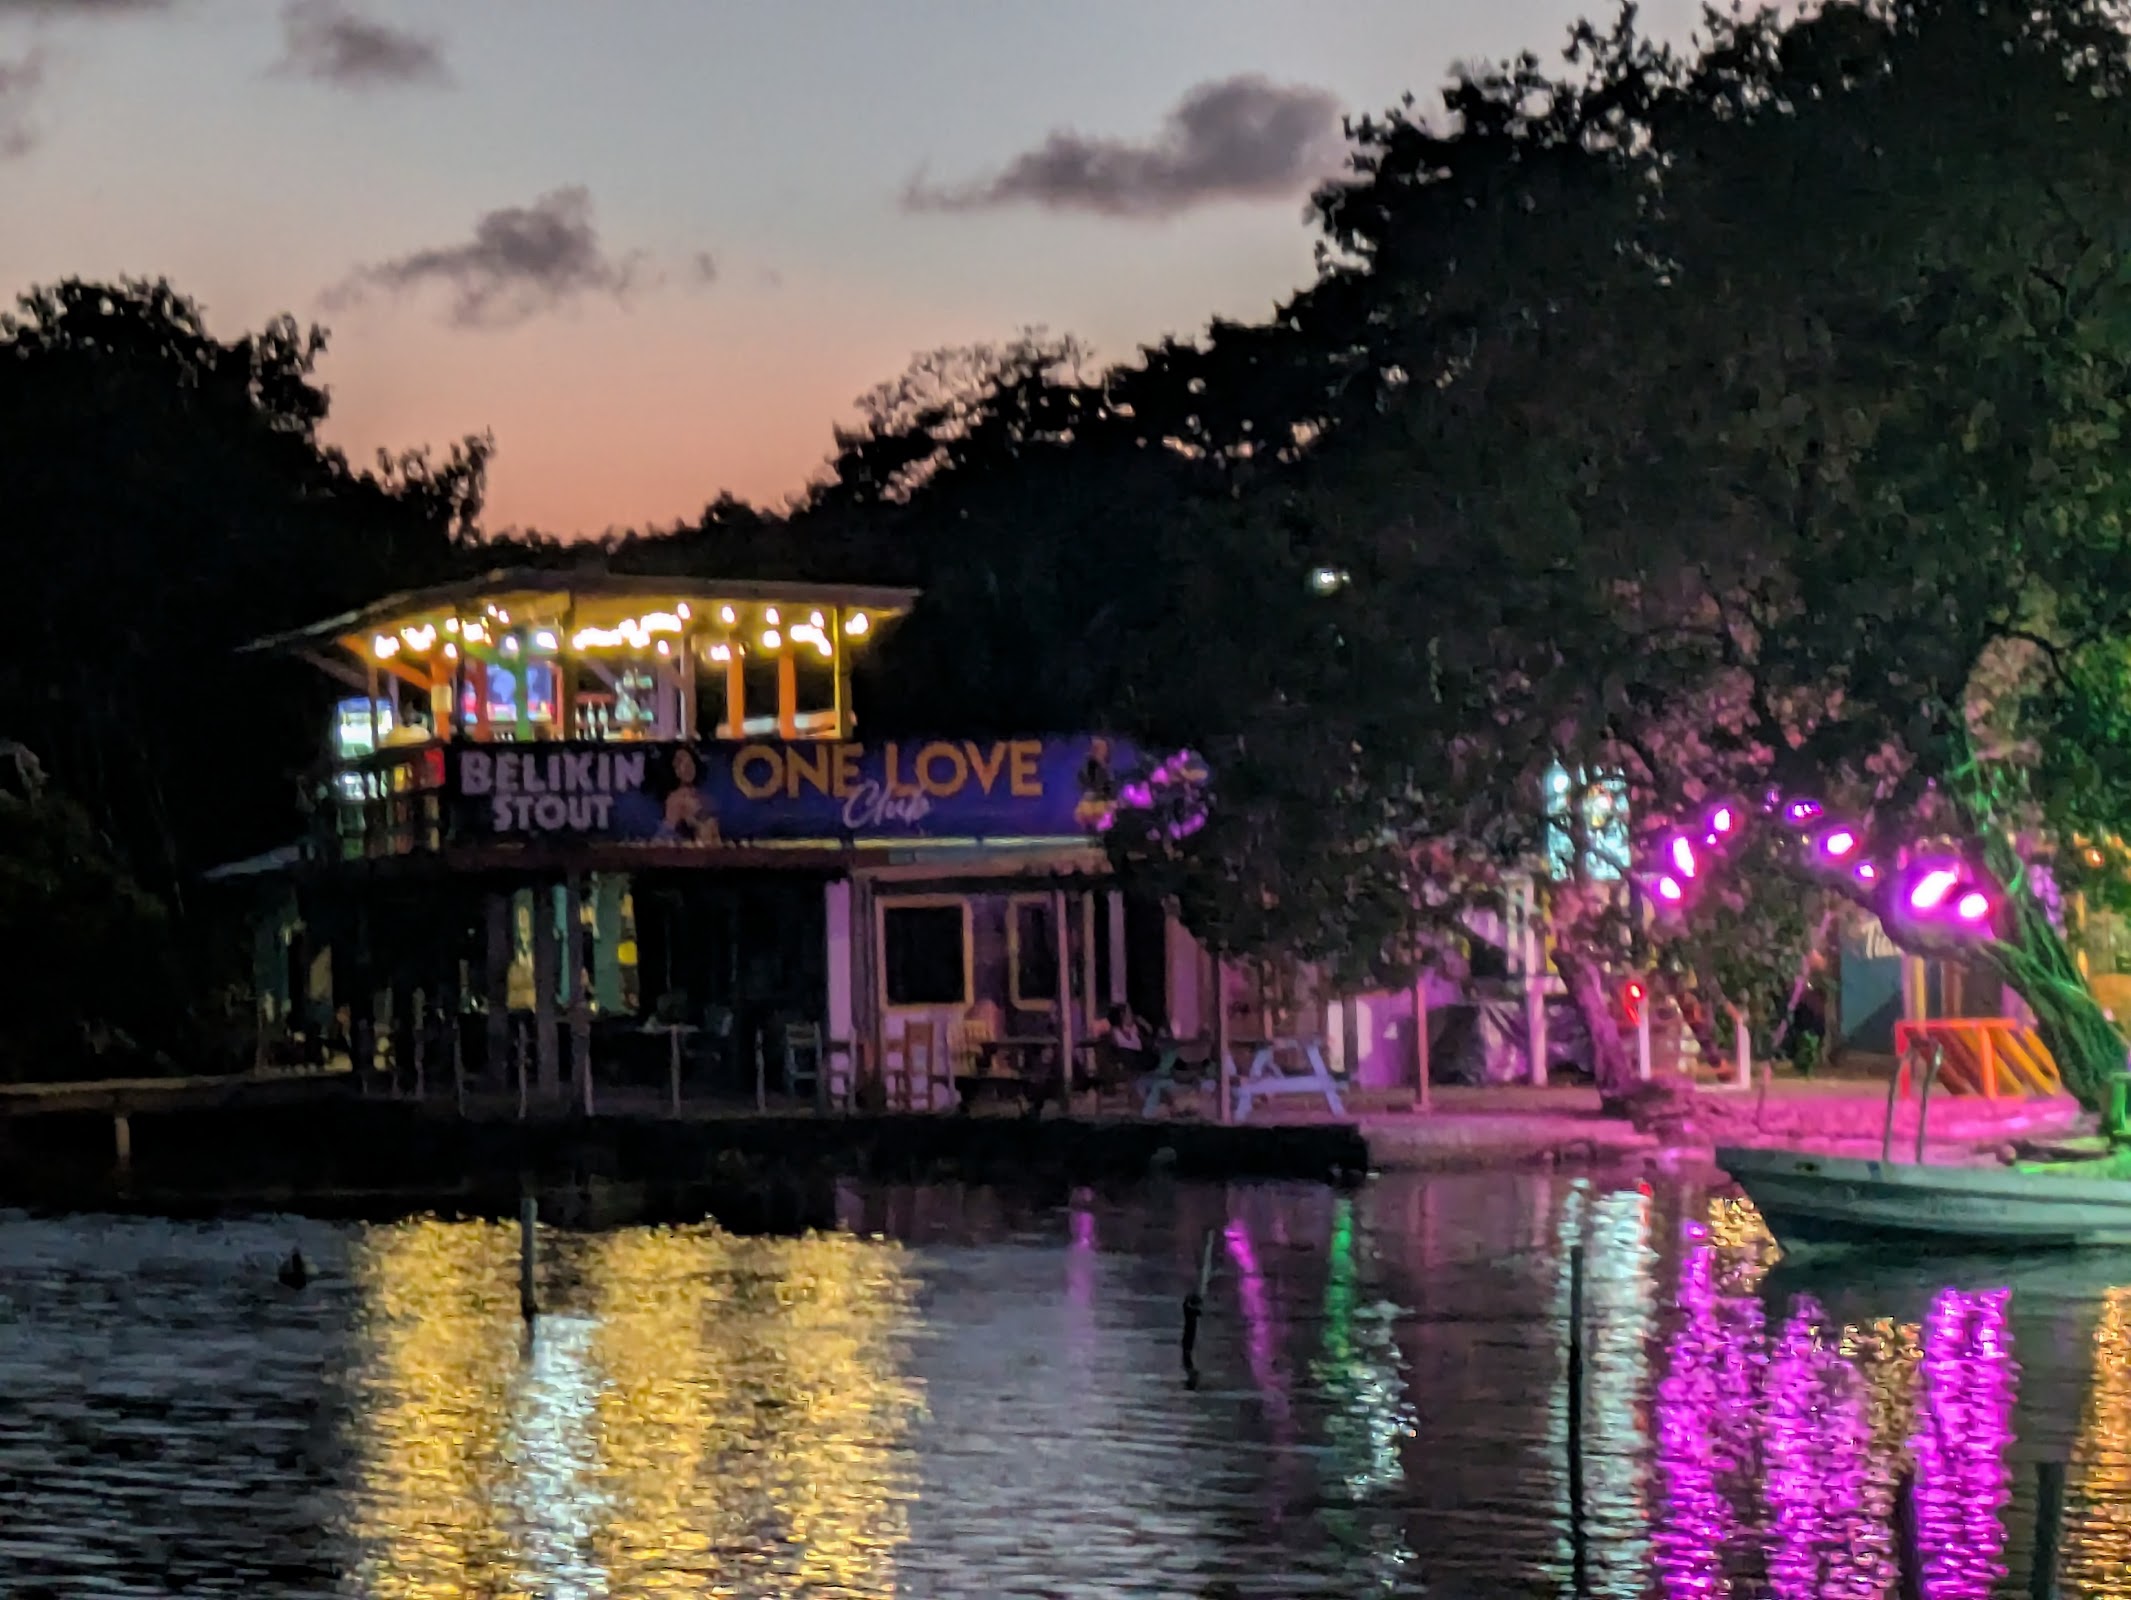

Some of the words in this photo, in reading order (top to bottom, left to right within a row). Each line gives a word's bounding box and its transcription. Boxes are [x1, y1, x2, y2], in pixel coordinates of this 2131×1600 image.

[460, 750, 645, 794] BELIKIN
[732, 743, 863, 799] ONE
[886, 741, 1043, 797] LOVE
[493, 795, 613, 832] STOUT
[842, 778, 931, 828] Club
